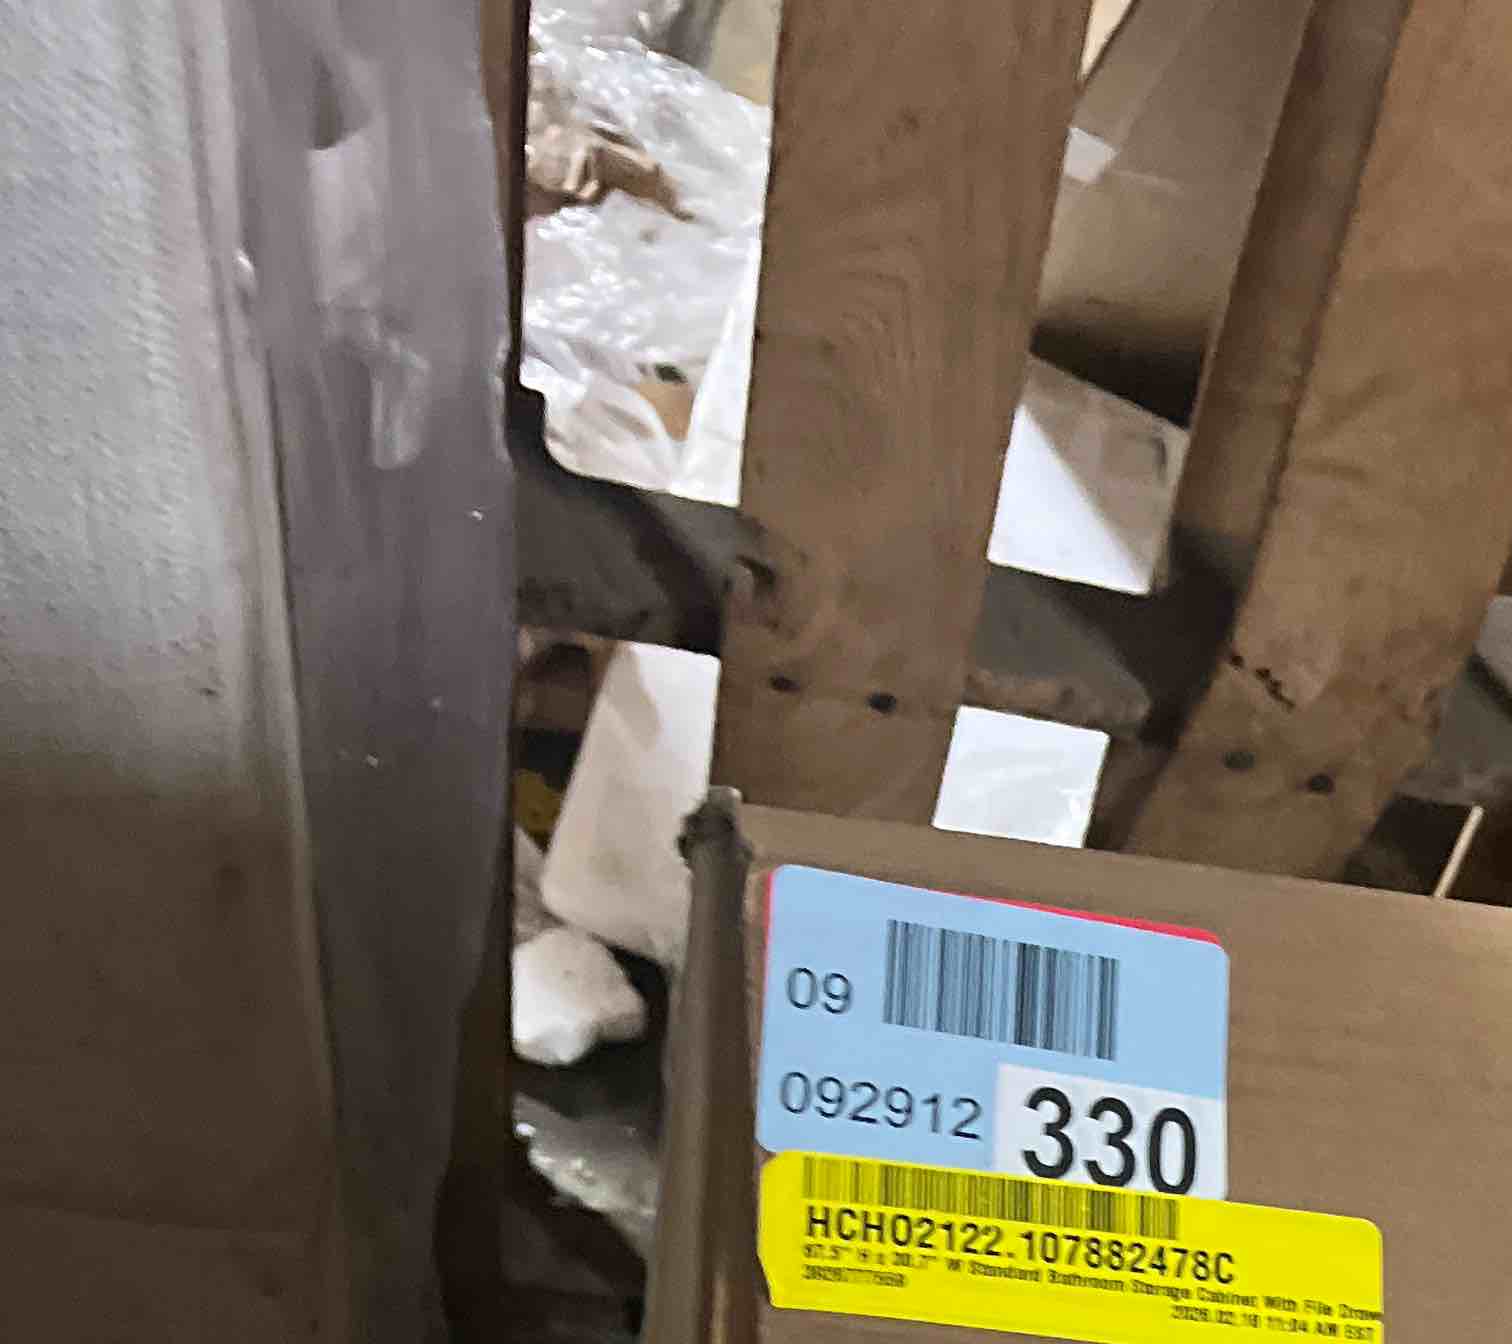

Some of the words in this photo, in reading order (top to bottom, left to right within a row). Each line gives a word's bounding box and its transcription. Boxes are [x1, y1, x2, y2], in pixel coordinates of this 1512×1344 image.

[786, 967, 853, 1015] 09
[780, 1071, 982, 1141] 092912
[1022, 1087, 1197, 1195] 330
[1048, 1268, 1125, 1292] Bathroom
[1130, 1278, 1190, 1301] Storage
[1197, 1286, 1258, 1308] Cabinet
